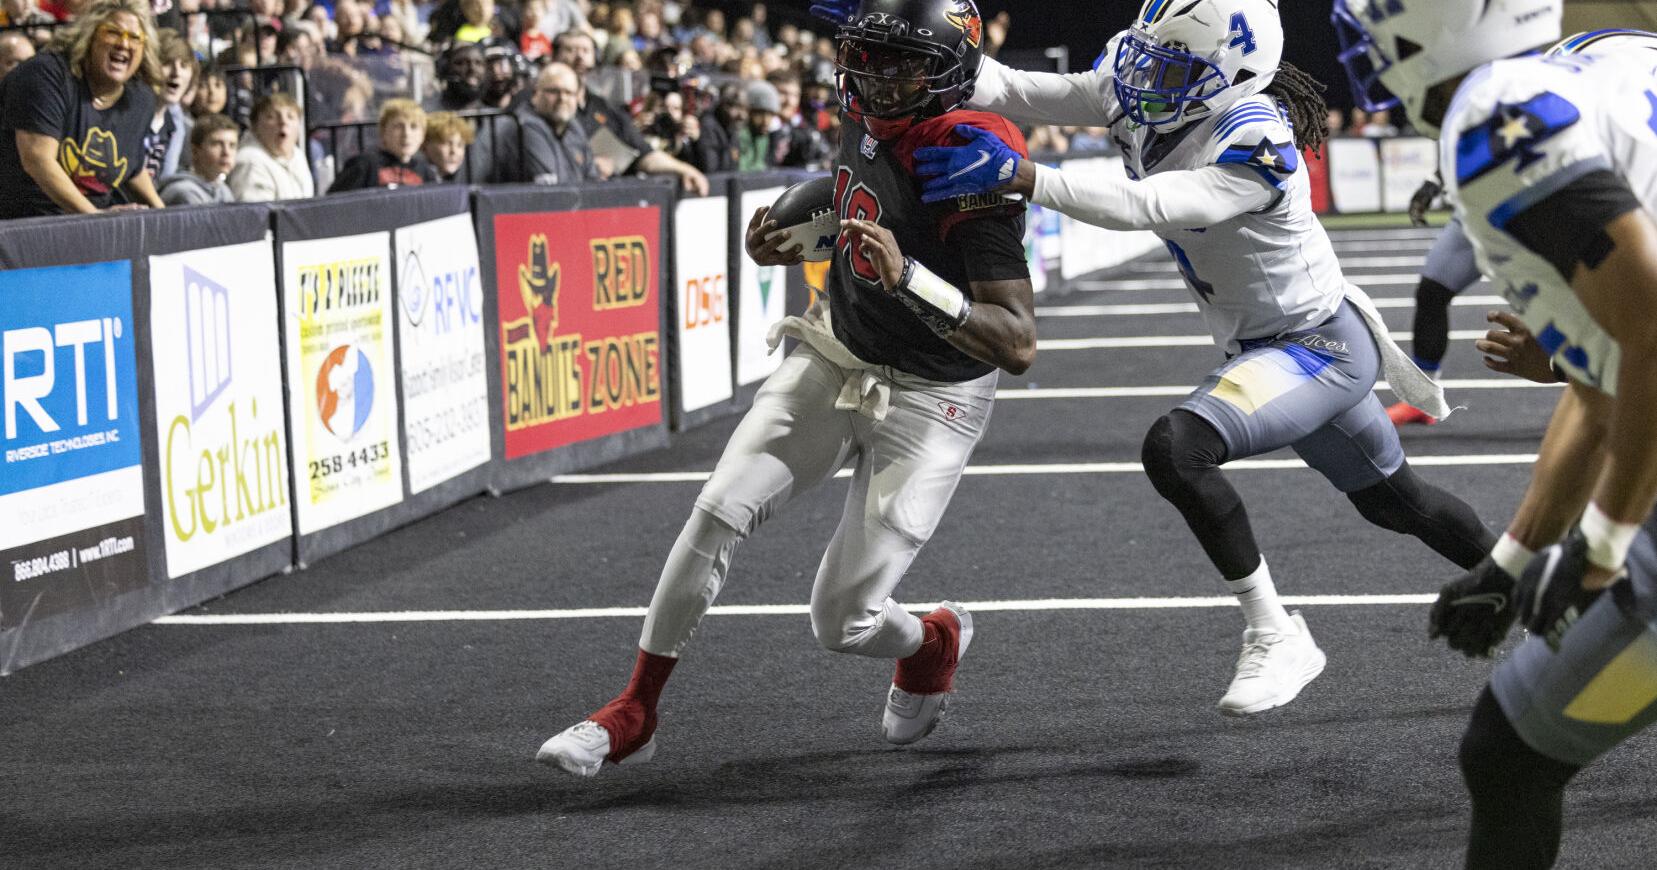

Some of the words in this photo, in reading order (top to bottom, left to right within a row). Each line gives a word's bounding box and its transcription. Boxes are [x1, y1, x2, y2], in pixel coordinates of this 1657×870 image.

[1228, 10, 1257, 57] 4
[325, 267, 334, 311] 2
[590, 235, 650, 311] RED
[434, 266, 480, 336] RFVC
[1297, 334, 1349, 353] Aces
[504, 333, 584, 431] BANDITS
[585, 331, 661, 415] ZONE
[5, 443, 49, 463] RIVERSIDE
[50, 431, 106, 454] TECHNOLOGIES
[166, 397, 286, 543] Gerkin
[308, 455, 342, 480] 258
[347, 440, 389, 468] 4433
